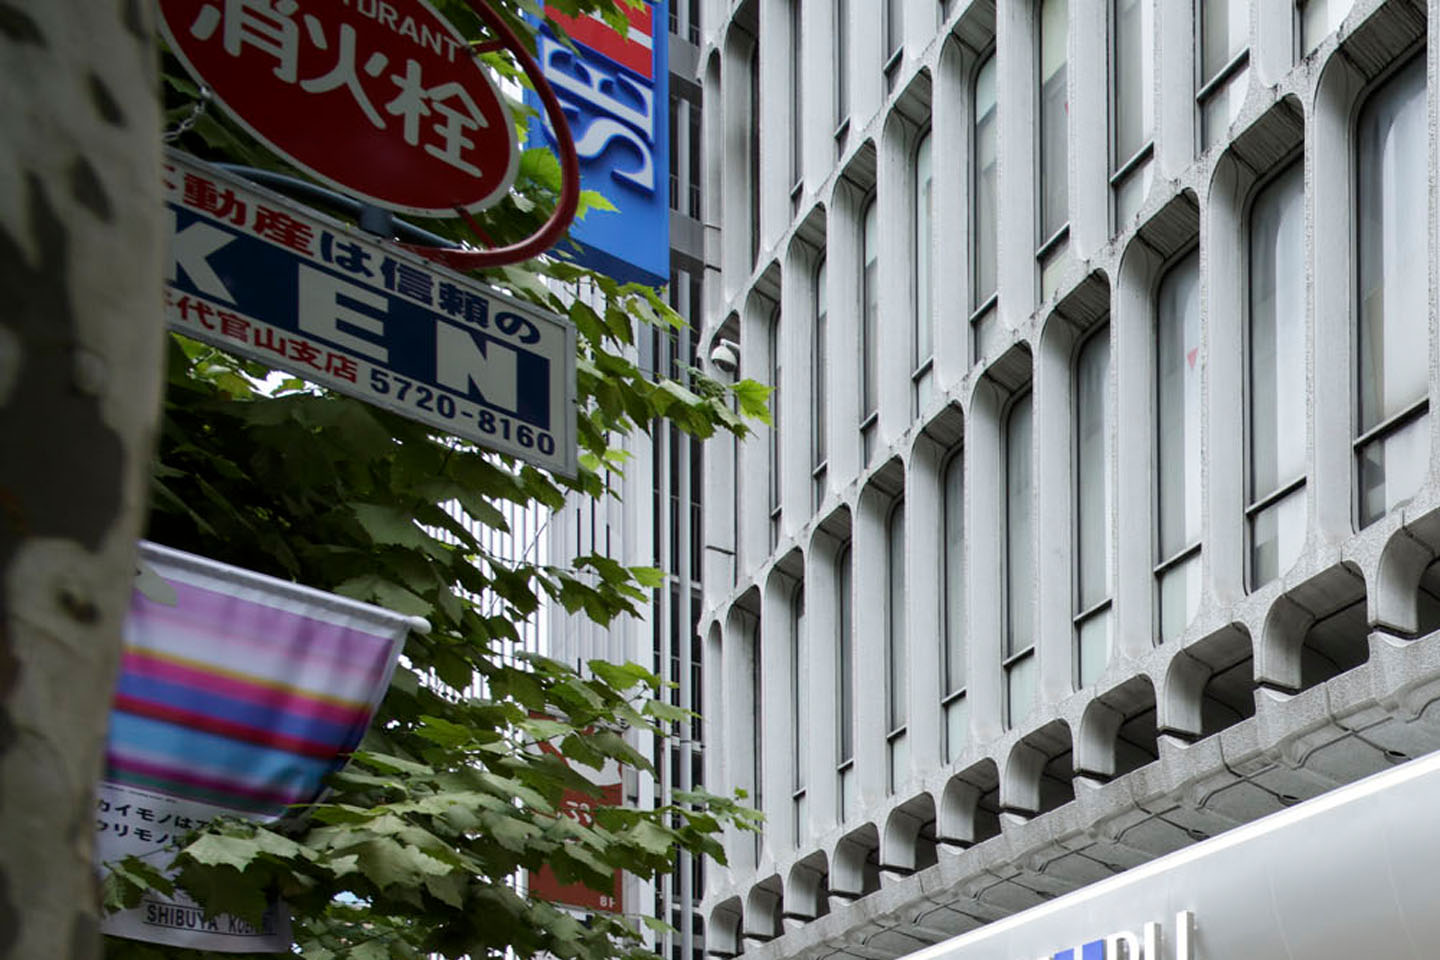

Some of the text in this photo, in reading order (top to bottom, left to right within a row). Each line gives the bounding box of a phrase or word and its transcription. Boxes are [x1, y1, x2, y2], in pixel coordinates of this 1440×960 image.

[190, 0, 488, 179] 消火栓
[344, 0, 461, 63] DRANT
[164, 163, 541, 345] 動産は信頼の
[170, 204, 518, 414] KEN
[166, 292, 556, 456] 代官山支店 5720-8160
